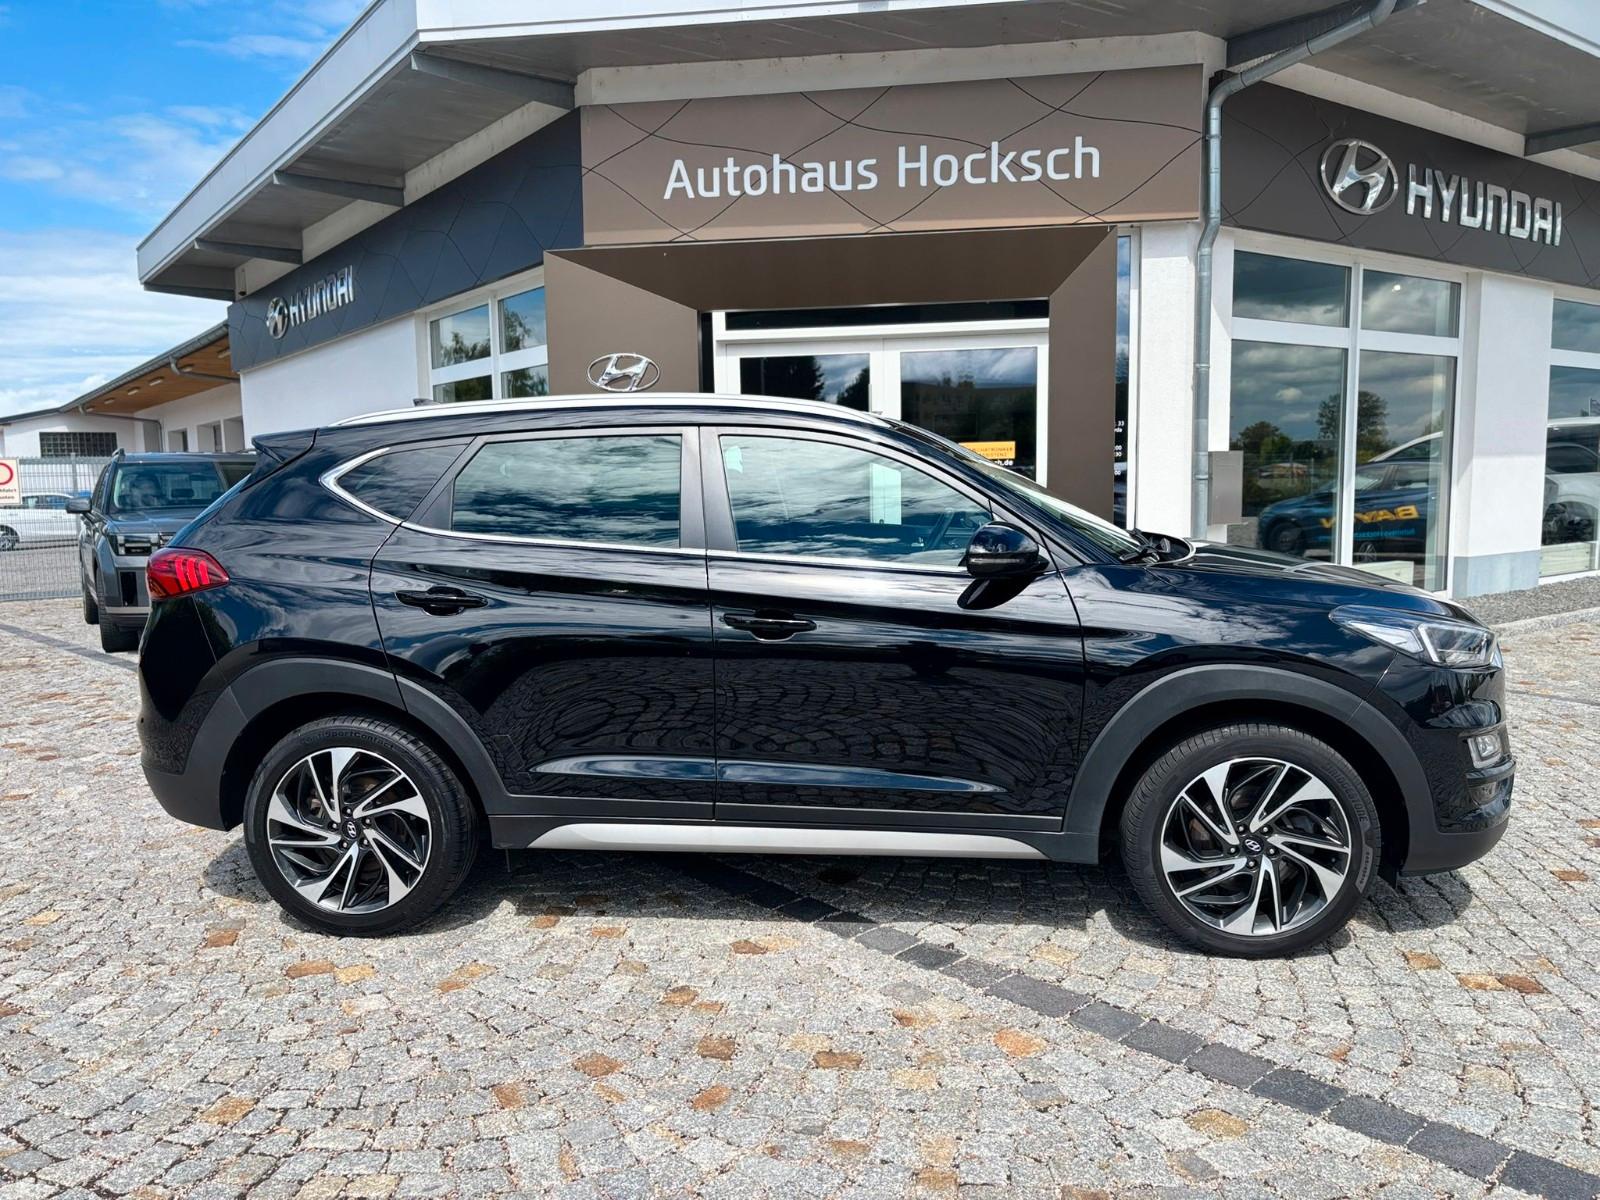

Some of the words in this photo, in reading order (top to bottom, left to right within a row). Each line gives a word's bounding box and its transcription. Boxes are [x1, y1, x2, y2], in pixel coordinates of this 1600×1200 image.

[663, 153, 879, 200] Autohaus
[897, 136, 1101, 188] Hocksch
[1406, 163, 1562, 247] HYUNDAI
[289, 265, 354, 327] HYUNDAI
